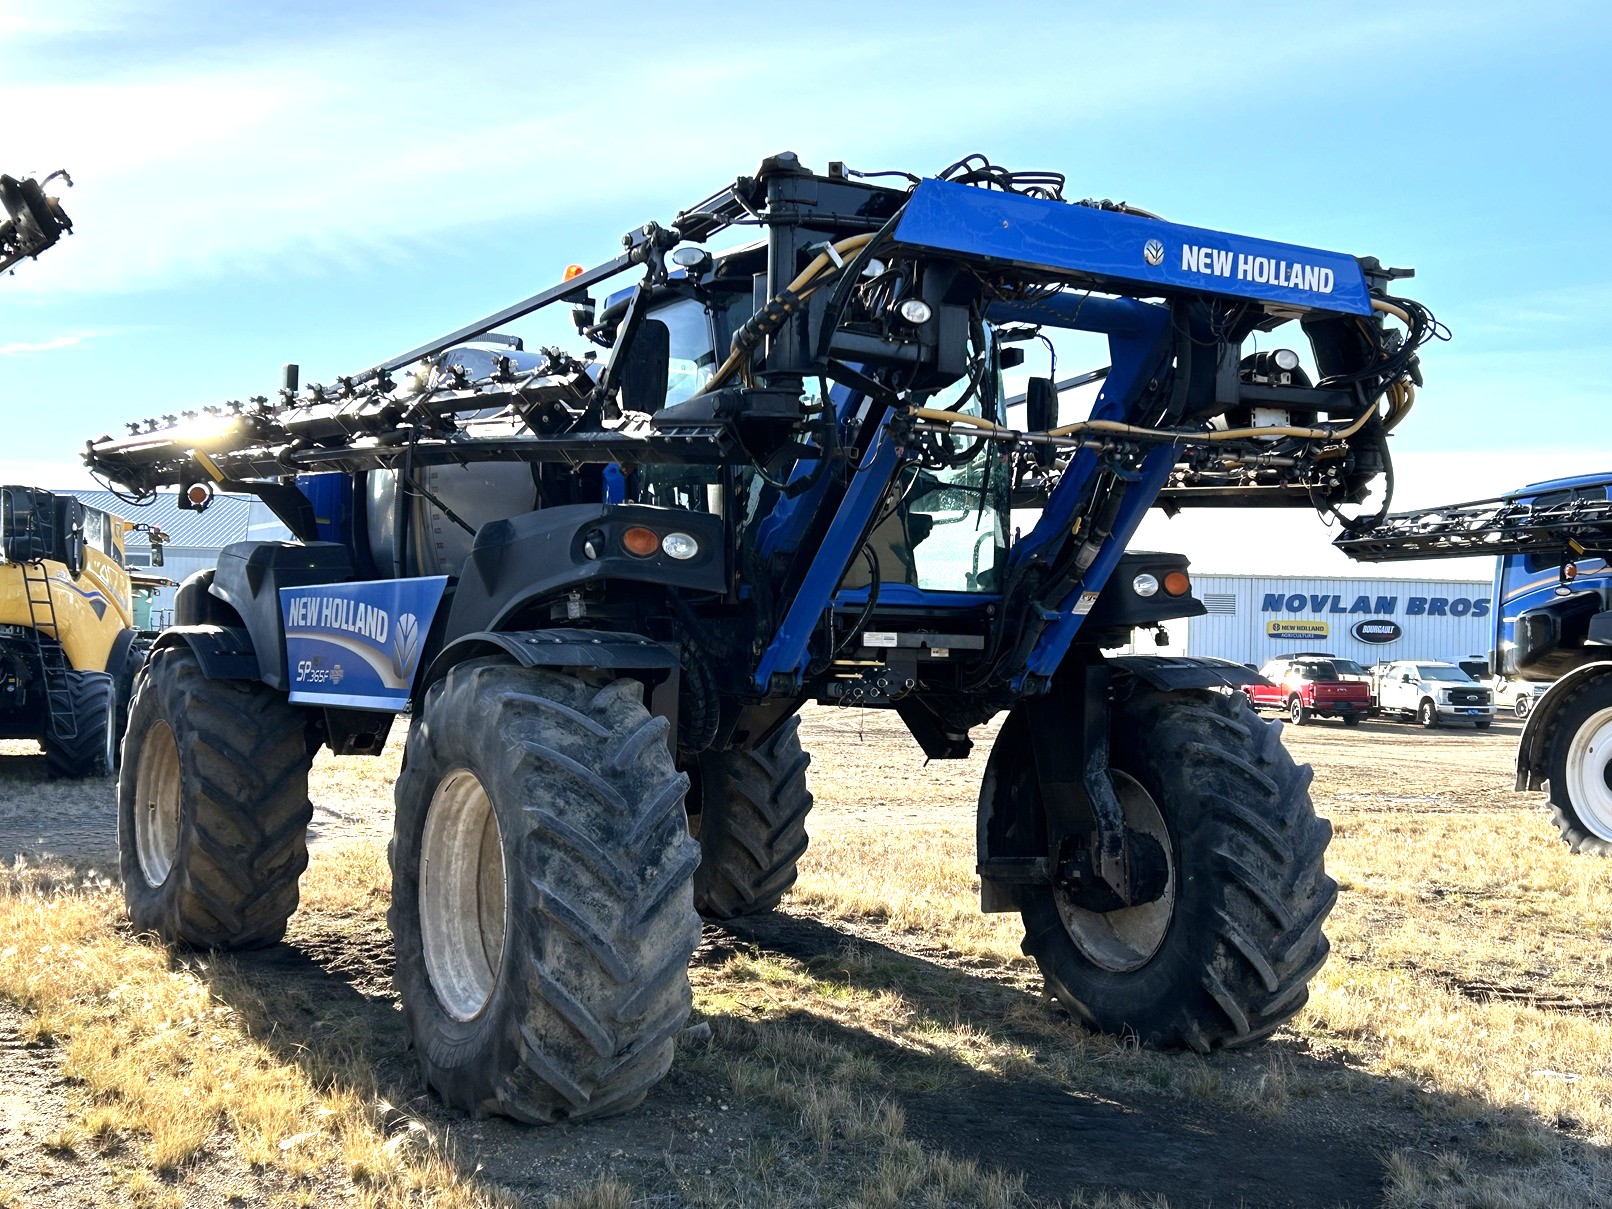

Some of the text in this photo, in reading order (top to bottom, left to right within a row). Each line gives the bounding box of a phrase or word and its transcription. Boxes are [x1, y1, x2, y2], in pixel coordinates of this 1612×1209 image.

[1181, 244, 1334, 294] NEW HOLLAND
[288, 597, 389, 644] NEW HOLLAND
[1261, 593, 1492, 617] NOVLAN BROS
